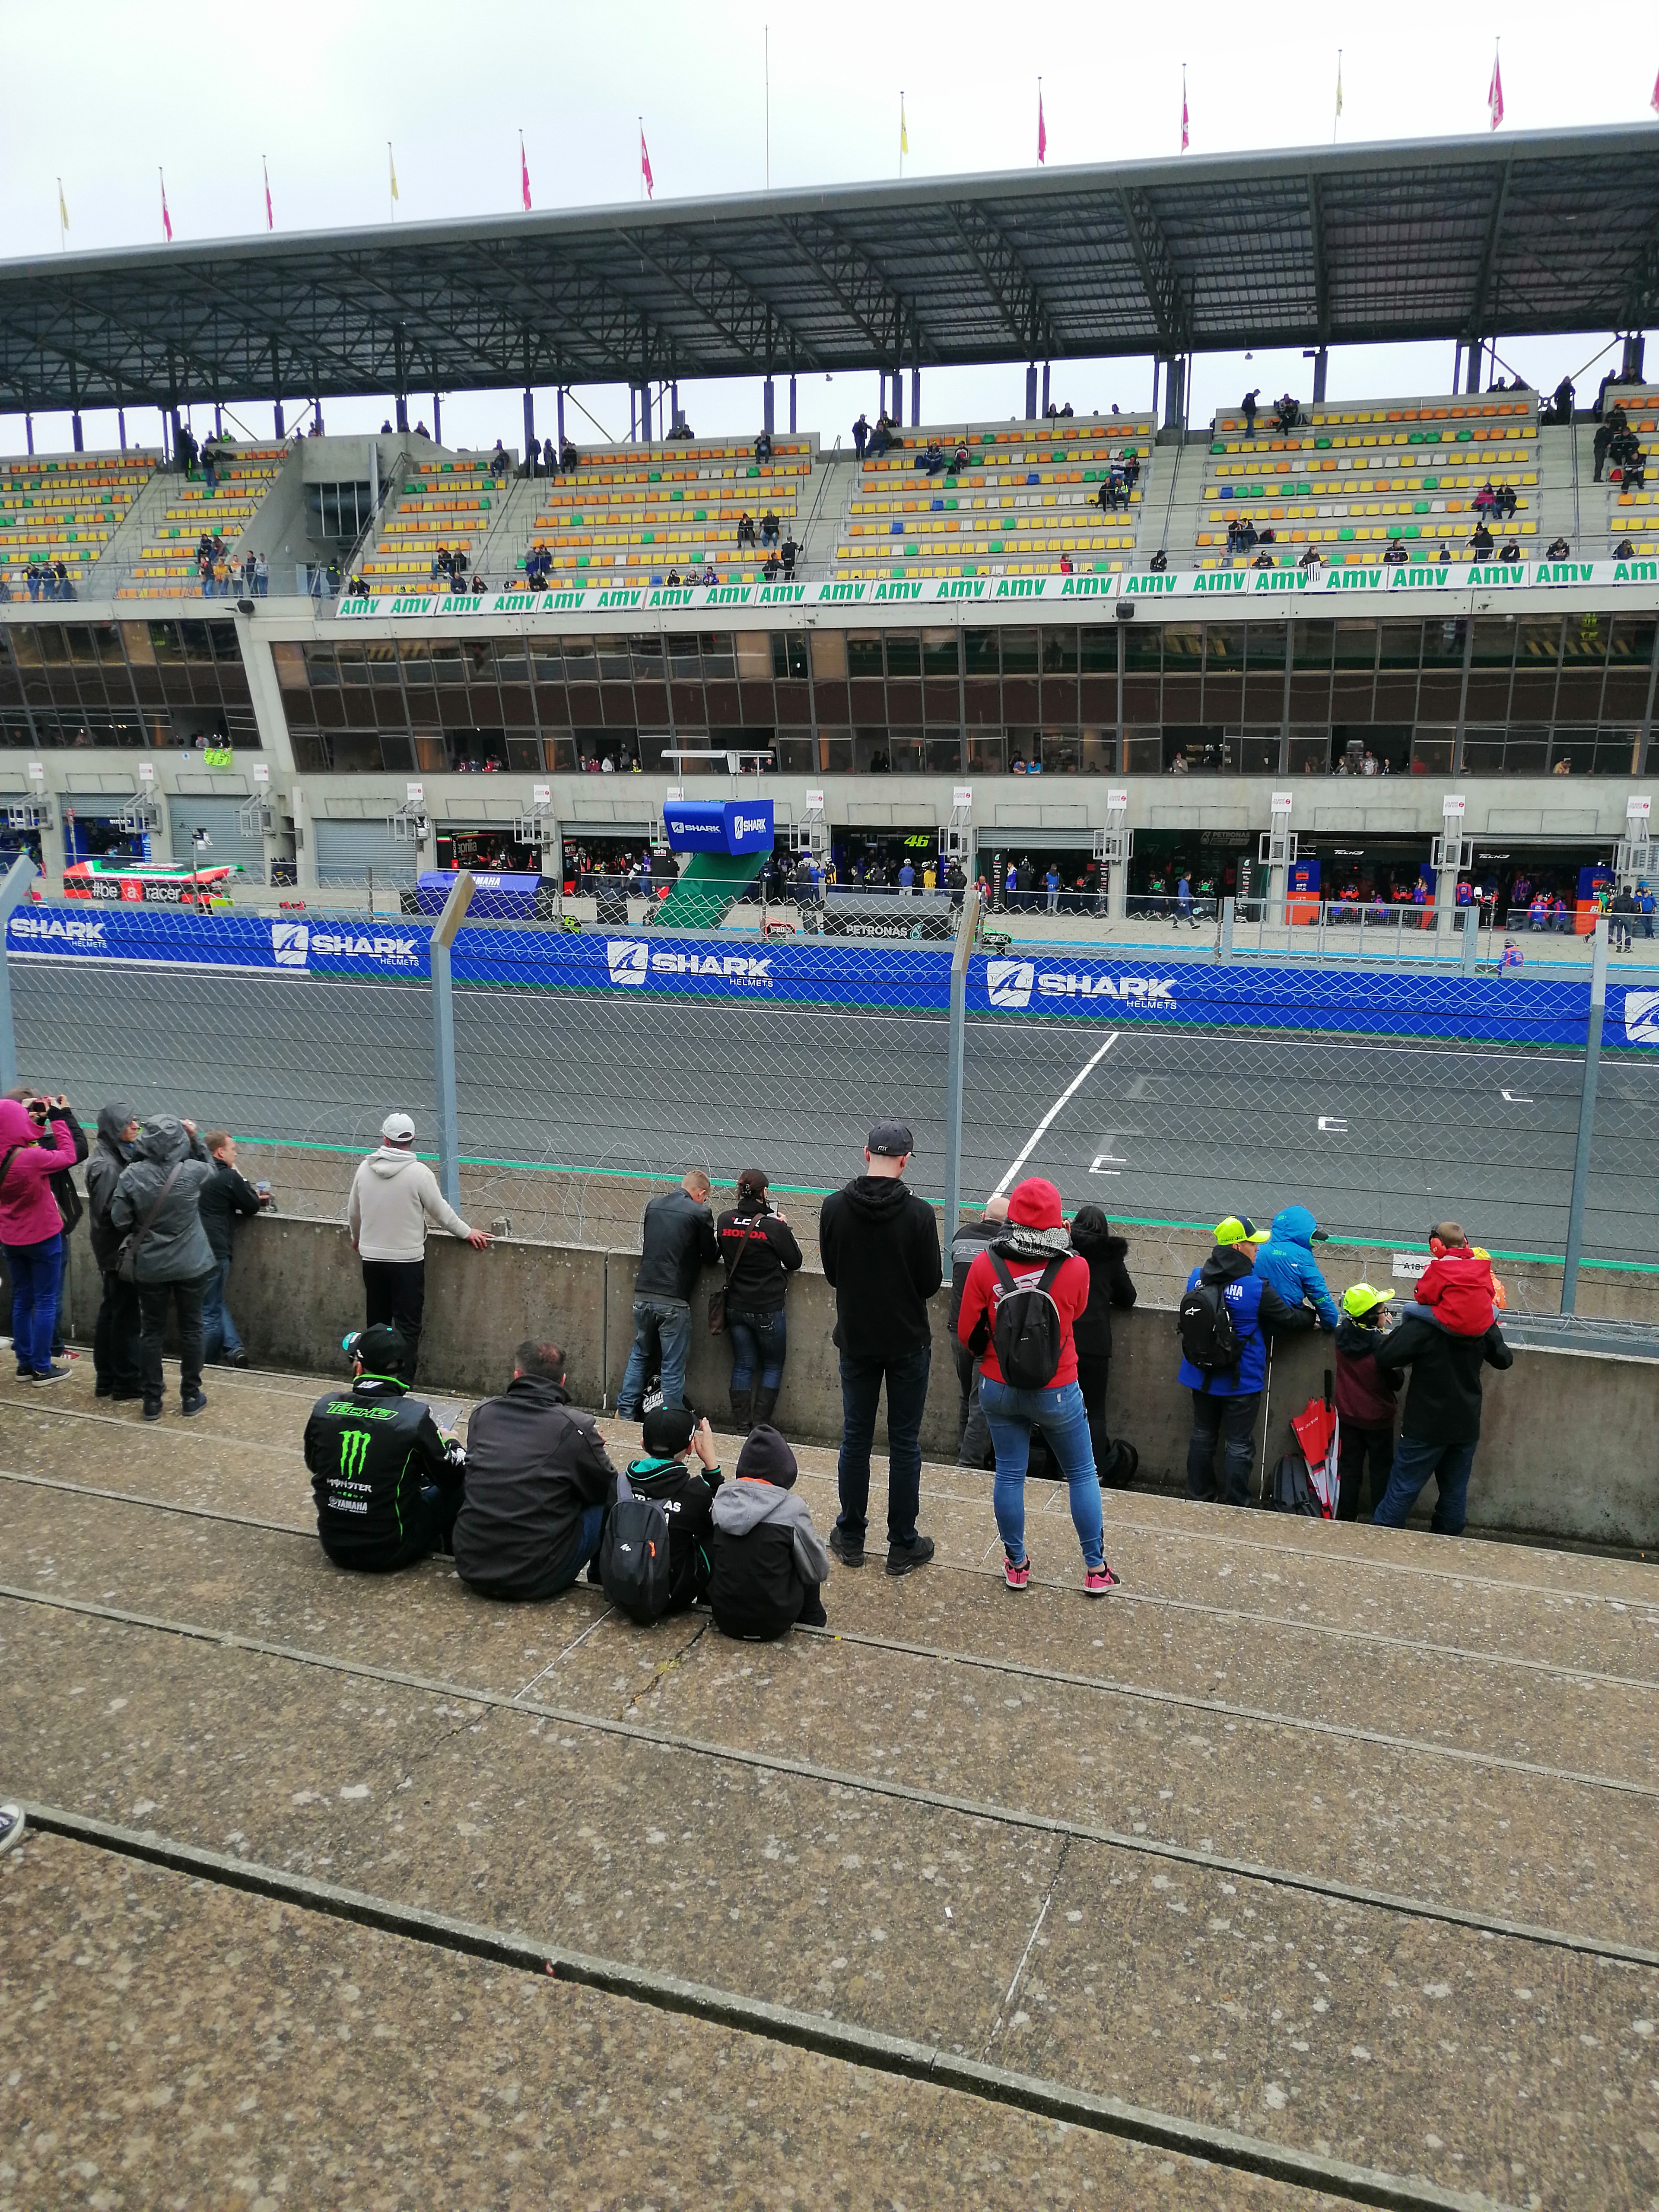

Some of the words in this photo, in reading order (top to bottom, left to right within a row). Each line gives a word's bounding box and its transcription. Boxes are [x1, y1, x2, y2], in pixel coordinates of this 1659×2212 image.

[743, 818, 766, 832] SHARK
[903, 834, 930, 847] 46
[92, 882, 118, 898] #be
[127, 887, 137, 898] a
[146, 887, 181, 900] racer
[10, 918, 106, 942] SHARK
[846, 925, 908, 937] PETRONAS
[71, 940, 107, 948] HELMETS
[311, 934, 419, 960] SHARK
[380, 957, 419, 966] HELMETS
[652, 953, 773, 981] SHARK
[729, 978, 774, 988] HELMETS
[1038, 973, 1178, 1002] SHARK
[1126, 1000, 1177, 1010] HELMETS
[1224, 1284, 1243, 1297] AHA
[326, 1478, 372, 1493] MONSTER
[337, 1497, 368, 1512] YAMAHA
